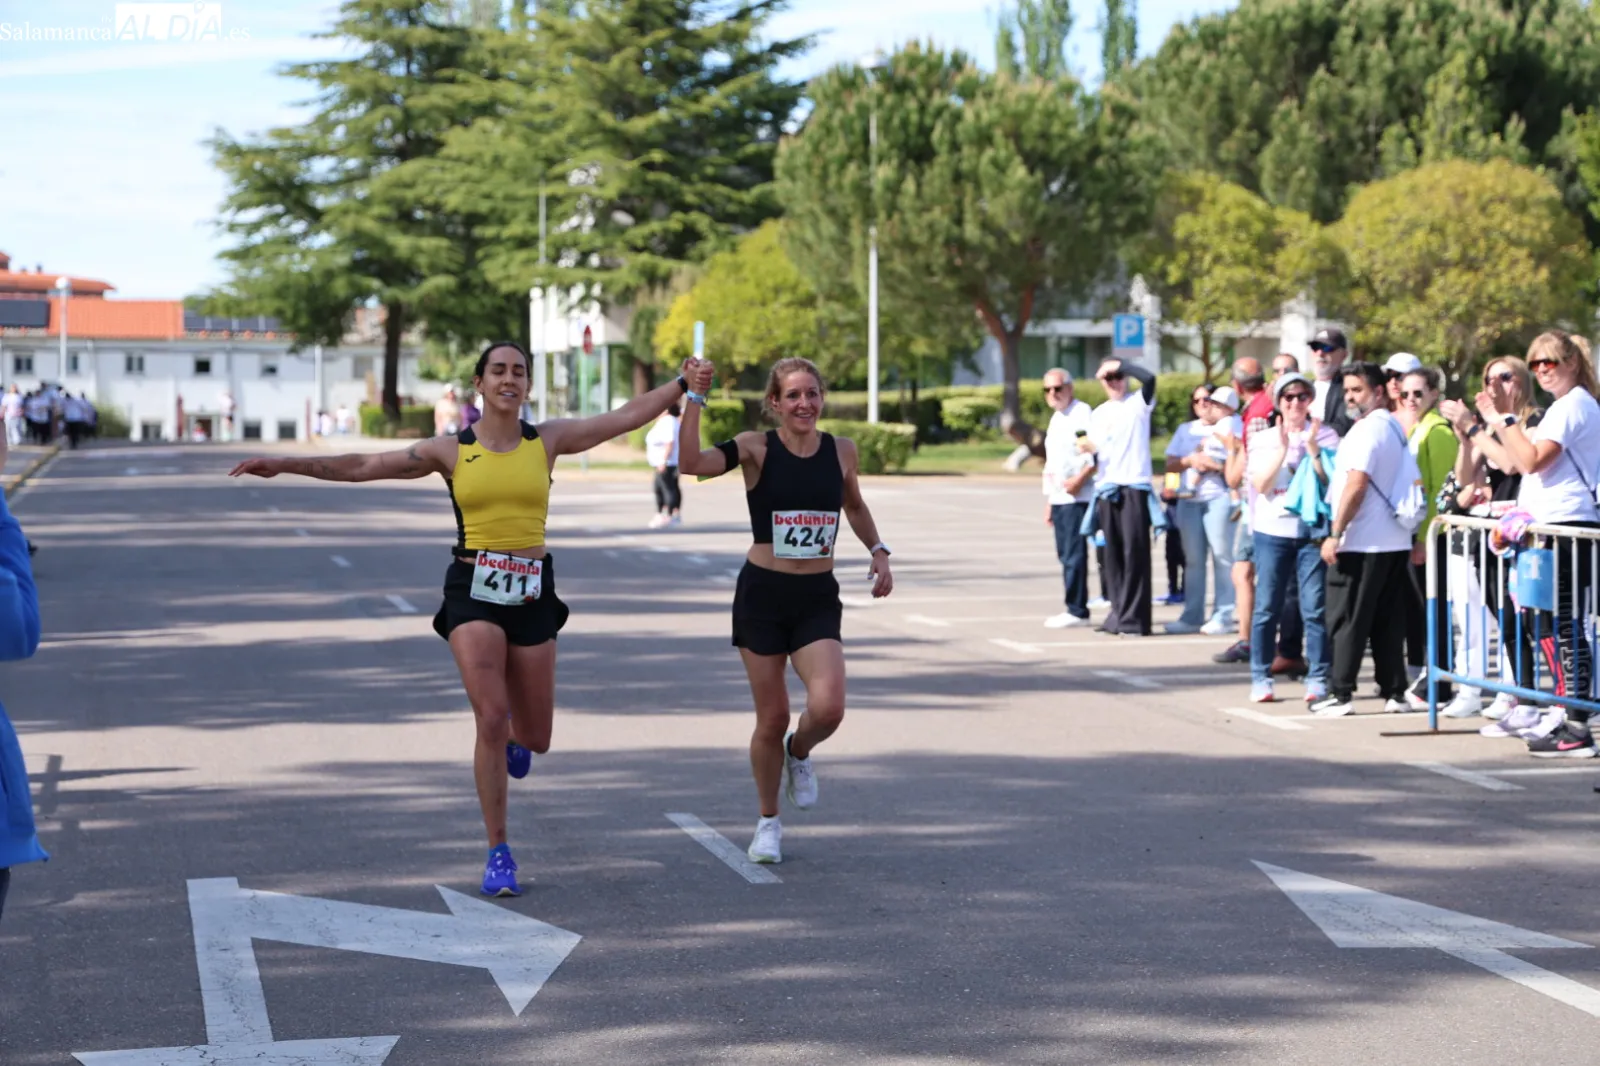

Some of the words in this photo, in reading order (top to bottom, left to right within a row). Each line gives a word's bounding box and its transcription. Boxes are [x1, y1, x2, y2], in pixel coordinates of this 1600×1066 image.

[1119, 317, 1140, 346] P
[783, 526, 826, 547] 424
[483, 570, 528, 596] 411
